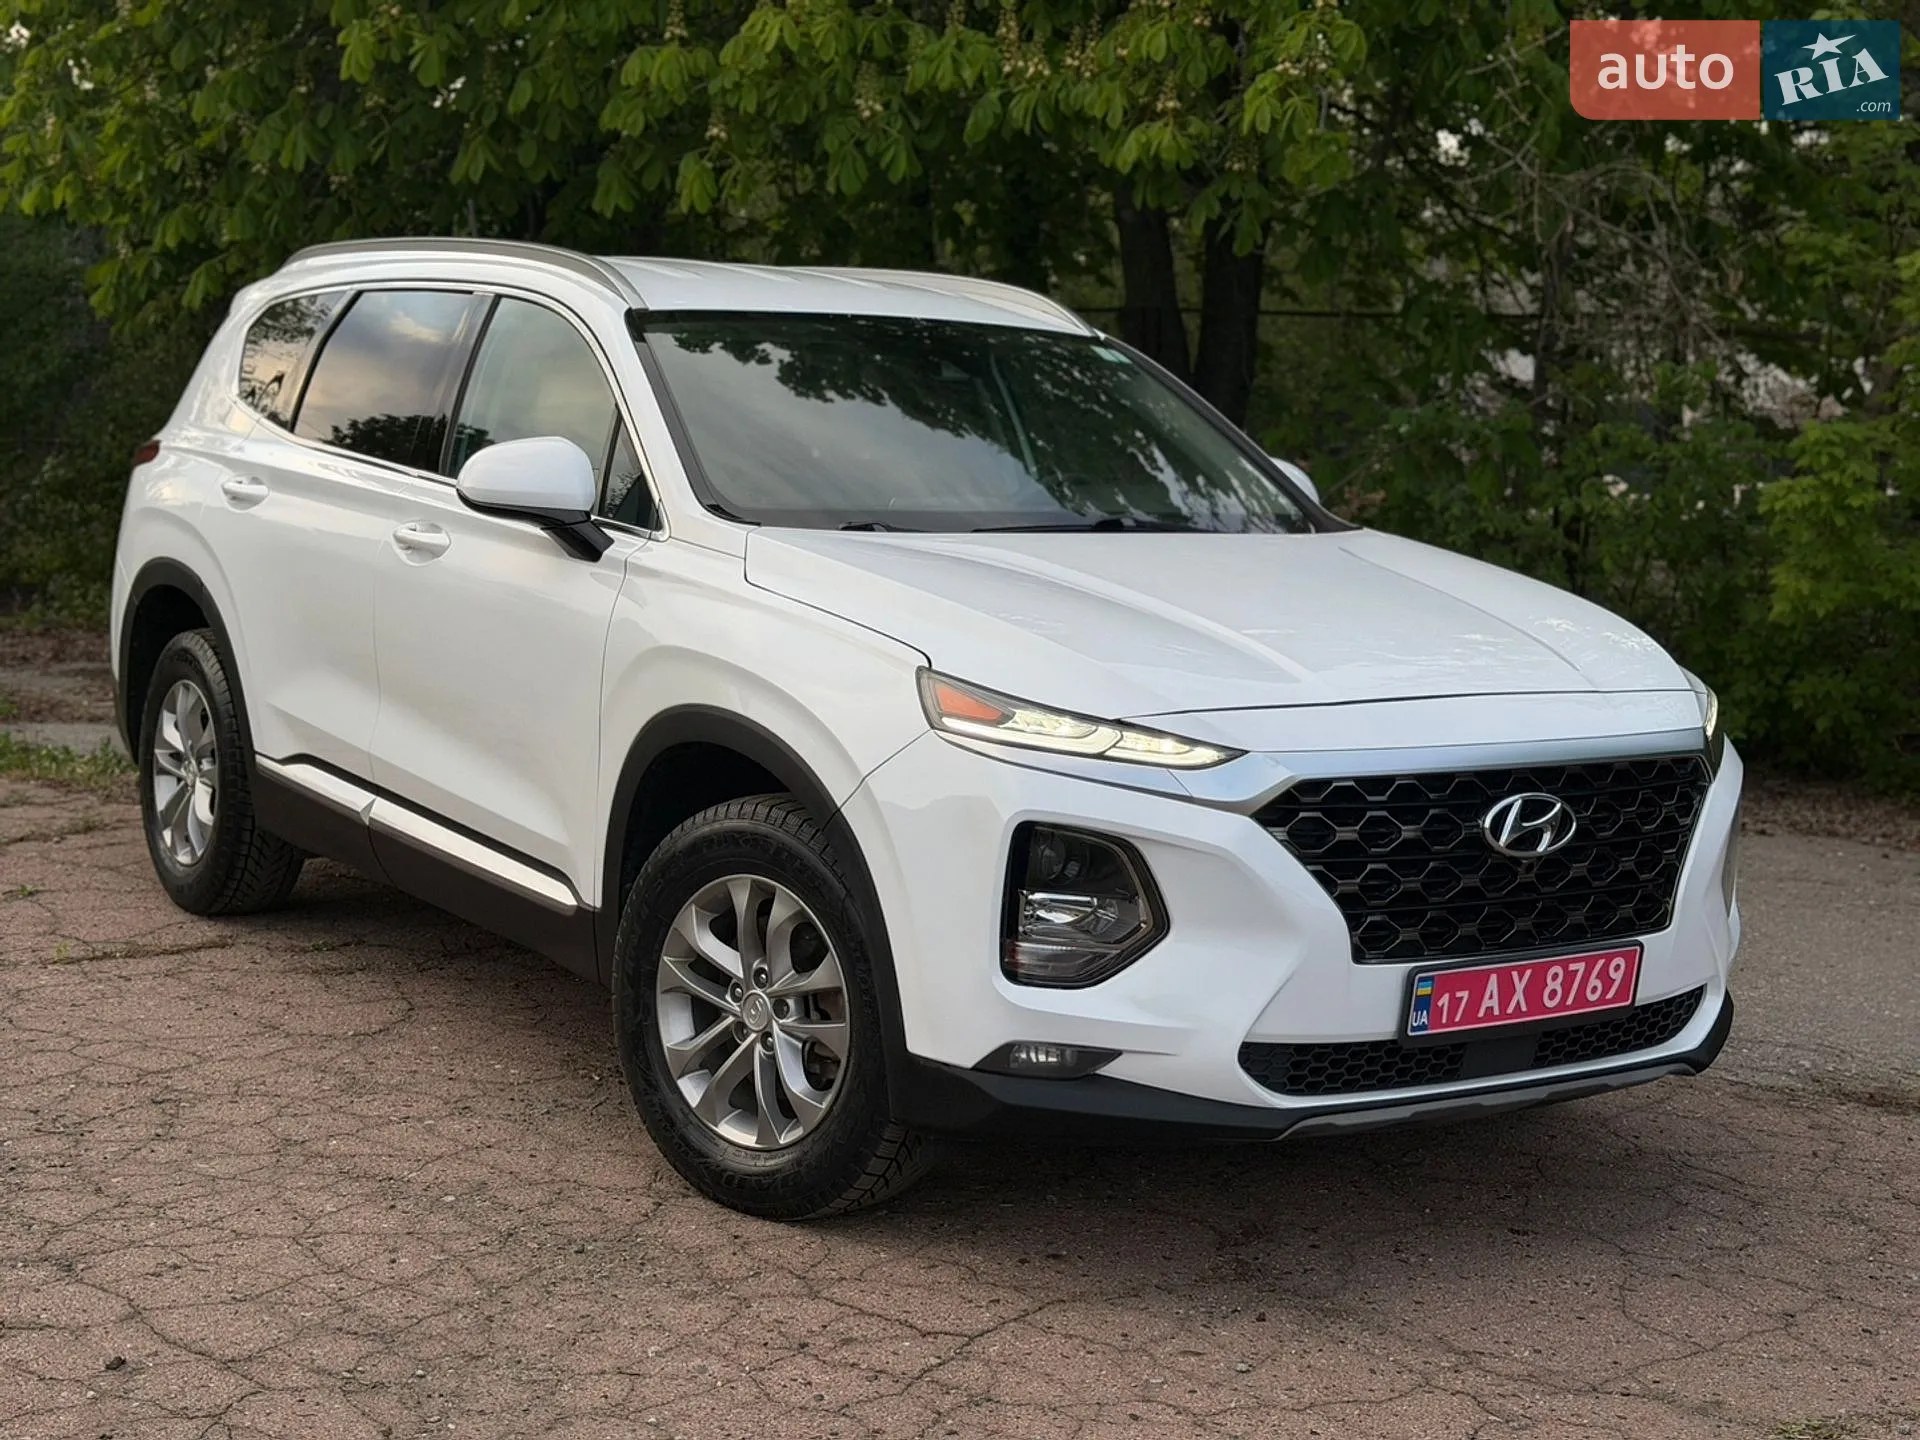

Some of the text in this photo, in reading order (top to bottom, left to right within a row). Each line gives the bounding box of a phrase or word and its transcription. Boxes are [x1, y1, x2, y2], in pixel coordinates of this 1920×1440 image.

[1436, 957, 1626, 1024] 17 AX 8769
[1412, 1010, 1428, 1027] UA
